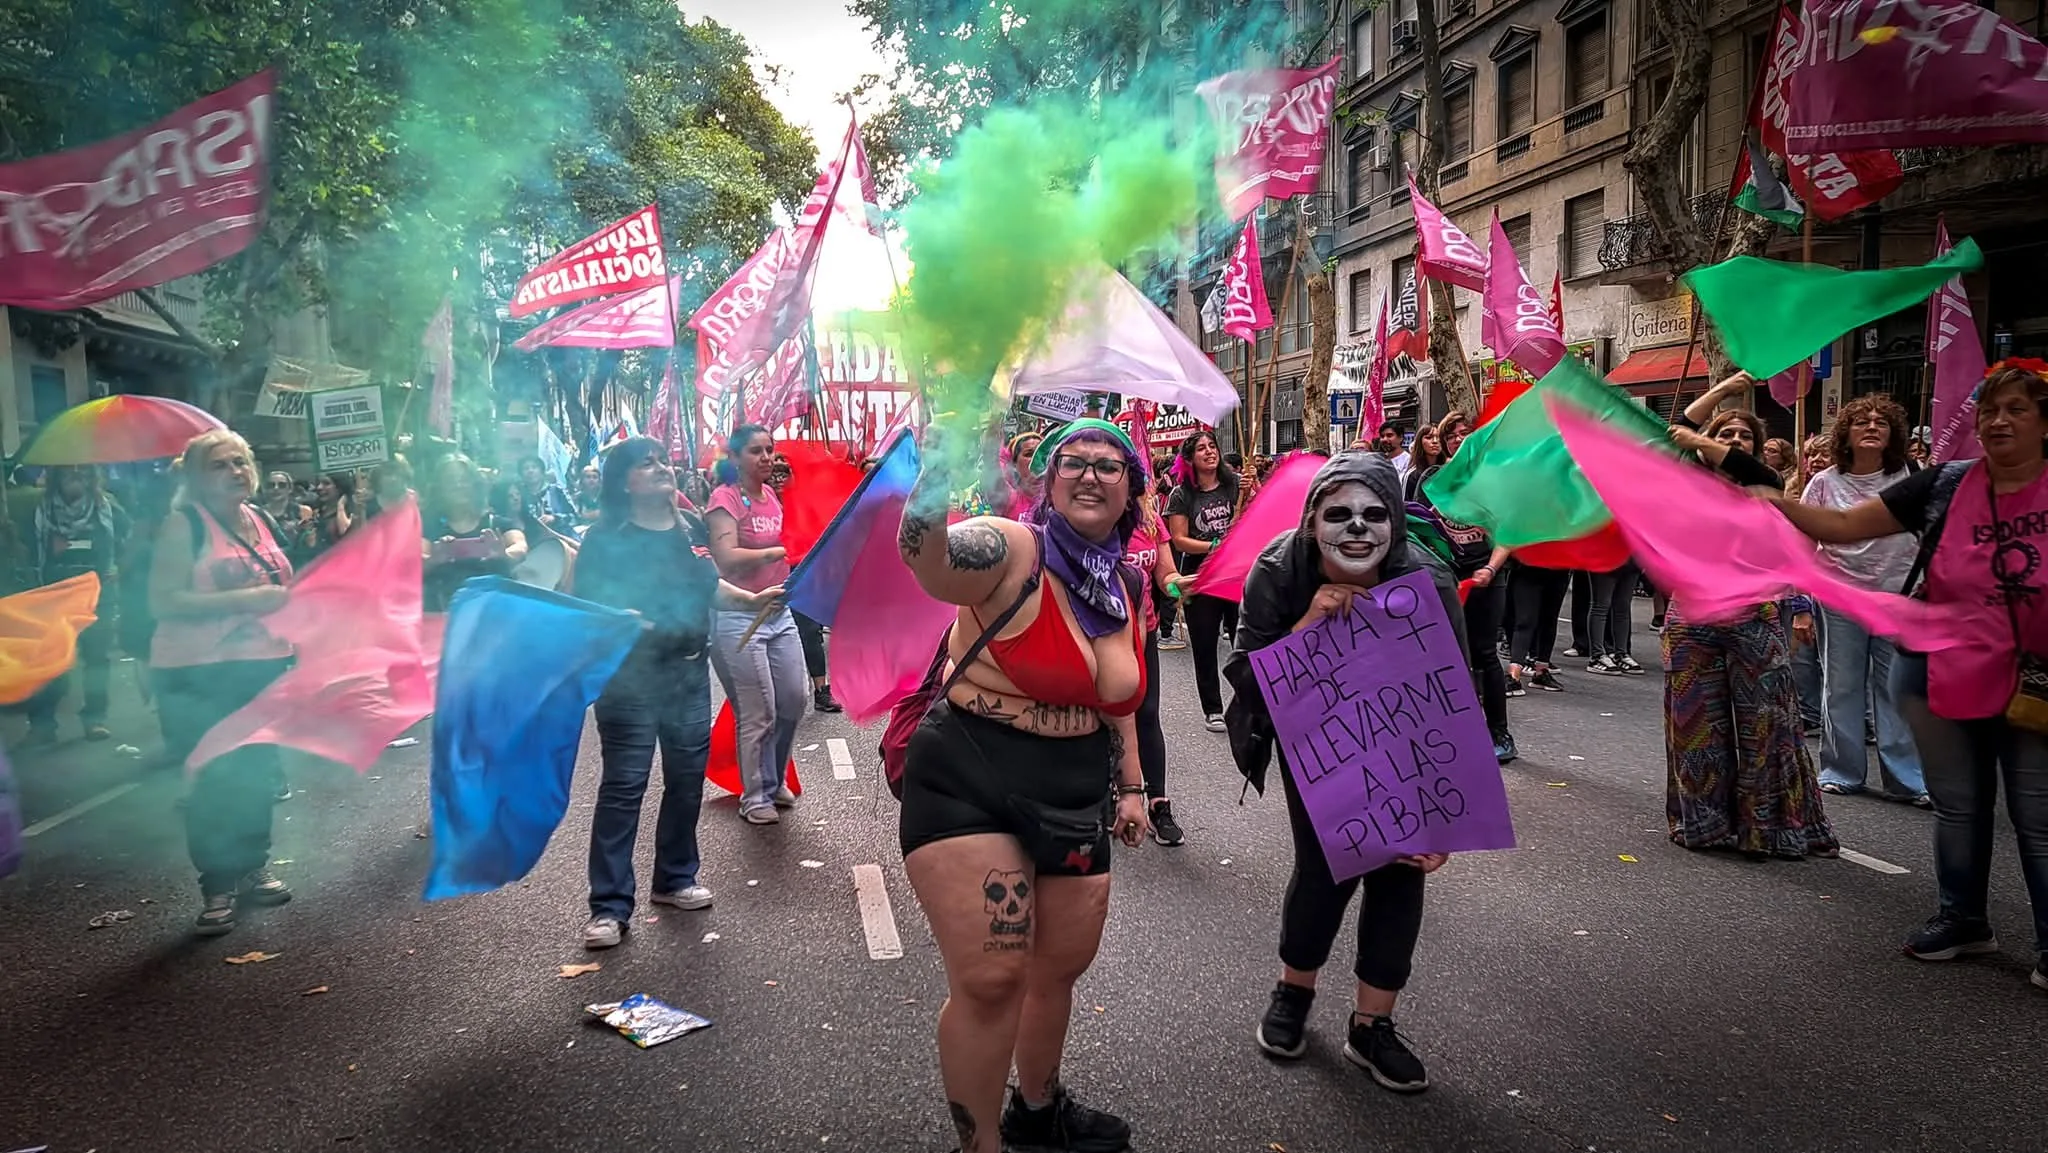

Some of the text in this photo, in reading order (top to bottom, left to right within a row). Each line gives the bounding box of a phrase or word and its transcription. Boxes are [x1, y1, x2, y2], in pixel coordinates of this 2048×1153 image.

[1032, 395, 1077, 414] EN LUCHA
[1257, 604, 1381, 706] HARTA
[1312, 663, 1360, 716] DE
[1291, 665, 1471, 784] LLEVARME
[1361, 728, 1457, 802] A LAS
